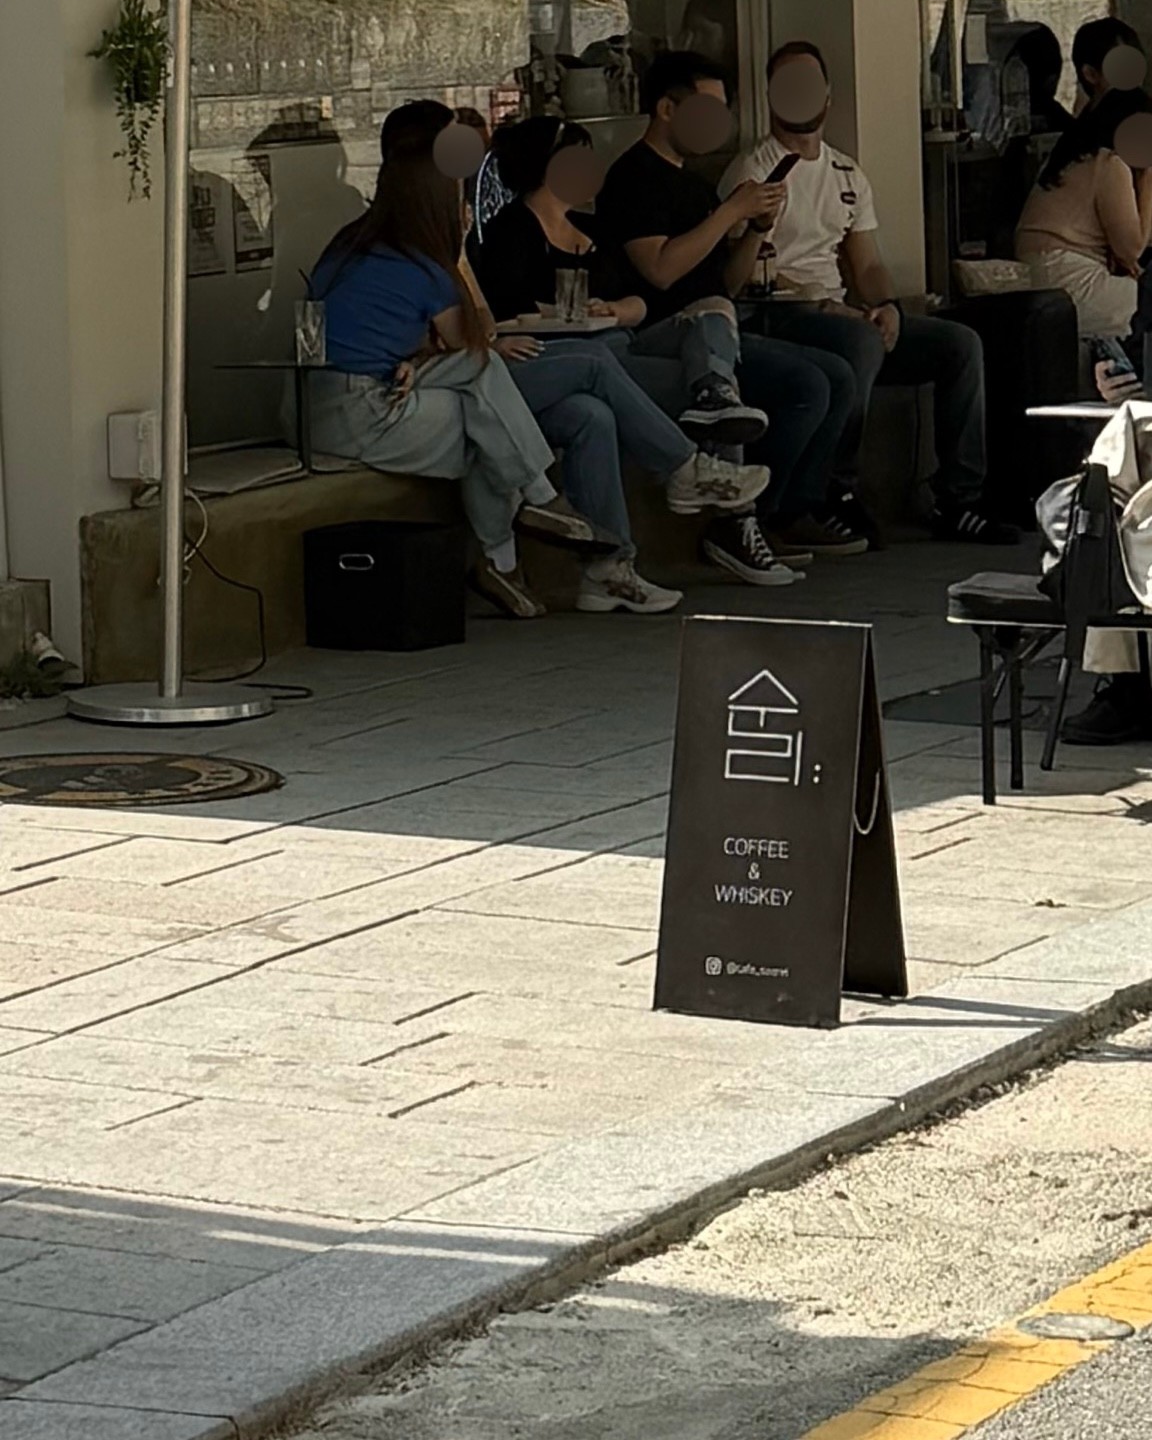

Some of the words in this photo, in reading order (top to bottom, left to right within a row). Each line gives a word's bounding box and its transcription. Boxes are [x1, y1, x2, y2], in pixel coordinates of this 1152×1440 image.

[723, 837, 789, 859] COFFEE
[747, 862, 760, 880] &
[714, 884, 793, 906] WHISKEY
